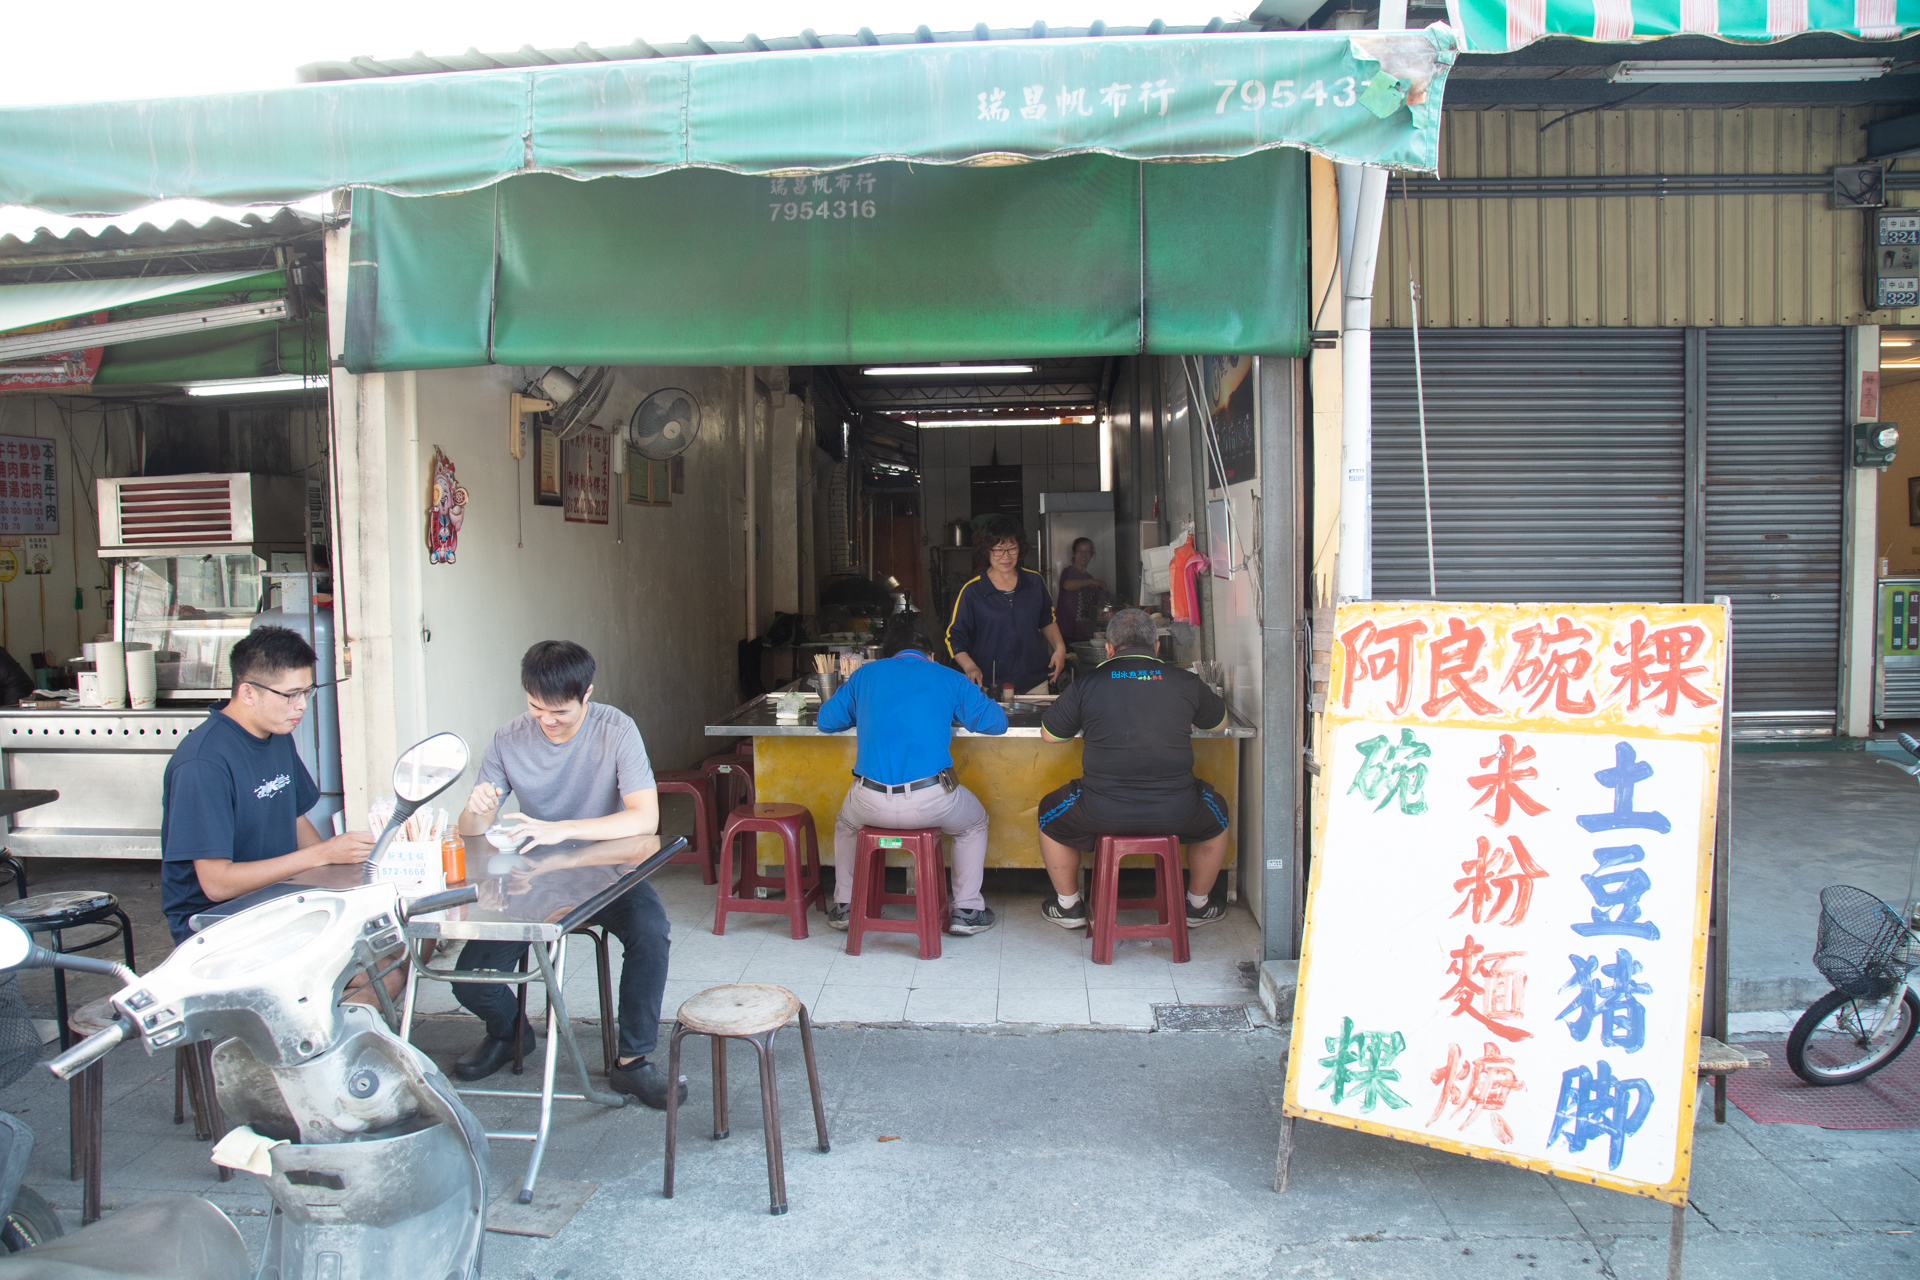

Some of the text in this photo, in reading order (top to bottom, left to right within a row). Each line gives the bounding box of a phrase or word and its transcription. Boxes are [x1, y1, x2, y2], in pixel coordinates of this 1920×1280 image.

[977, 75, 1370, 122] 瑞昌帆布行 79543
[770, 172, 877, 196] 瑞昌帆布行
[769, 199, 877, 222] 7954316
[1890, 219, 1916, 228] 中山路
[1888, 230, 1918, 244] 324
[1887, 292, 1915, 305] 322
[1888, 280, 1914, 289] 中山路
[6, 441, 20, 498] 牛肉湯
[18, 442, 31, 499] 炒麻油
[30, 443, 43, 499] 炒牛肉
[42, 443, 57, 522] 本產牛肉
[1339, 616, 1718, 717] 阿良碗粿
[382, 867, 426, 876] 572-1666
[1316, 728, 1431, 1108] 碗粿
[1426, 734, 1549, 1144] 米粉麵焿
